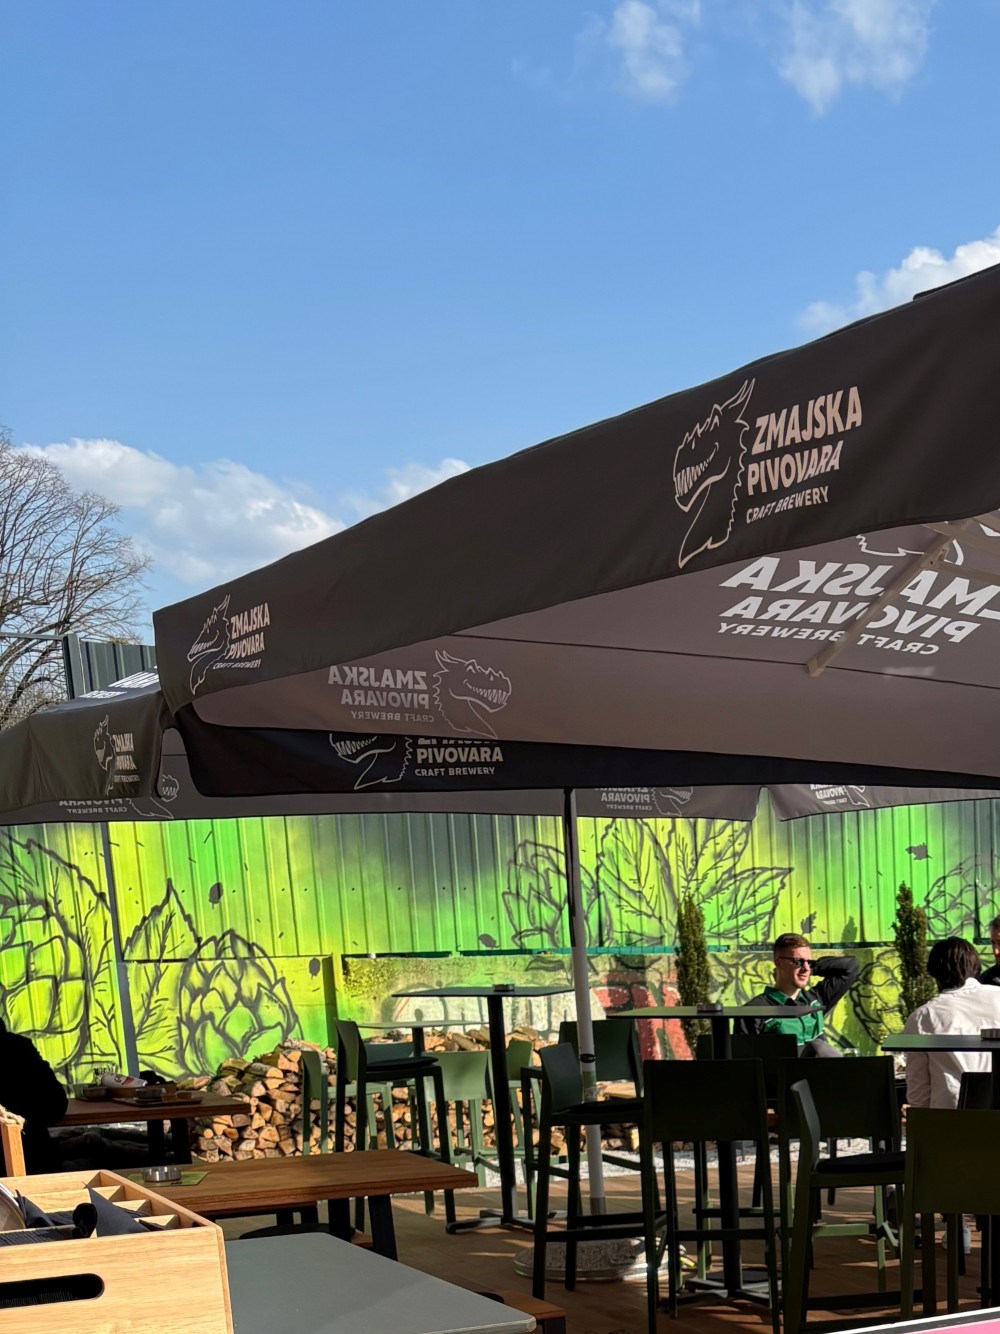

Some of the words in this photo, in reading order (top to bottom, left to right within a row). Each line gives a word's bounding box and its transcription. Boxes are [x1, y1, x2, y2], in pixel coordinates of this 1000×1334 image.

[752, 386, 862, 455] ZMAJSKA
[747, 440, 844, 496] PIVOVARA
[746, 501, 777, 524] CRAFT
[775, 486, 829, 513] BREWERY
[231, 602, 270, 640] ZMAJSKA
[225, 632, 265, 659] PIVOVARA
[414, 768, 445, 776] CRAFT
[448, 767, 495, 776] BREWERY
[417, 747, 503, 764] PIVOVARA
